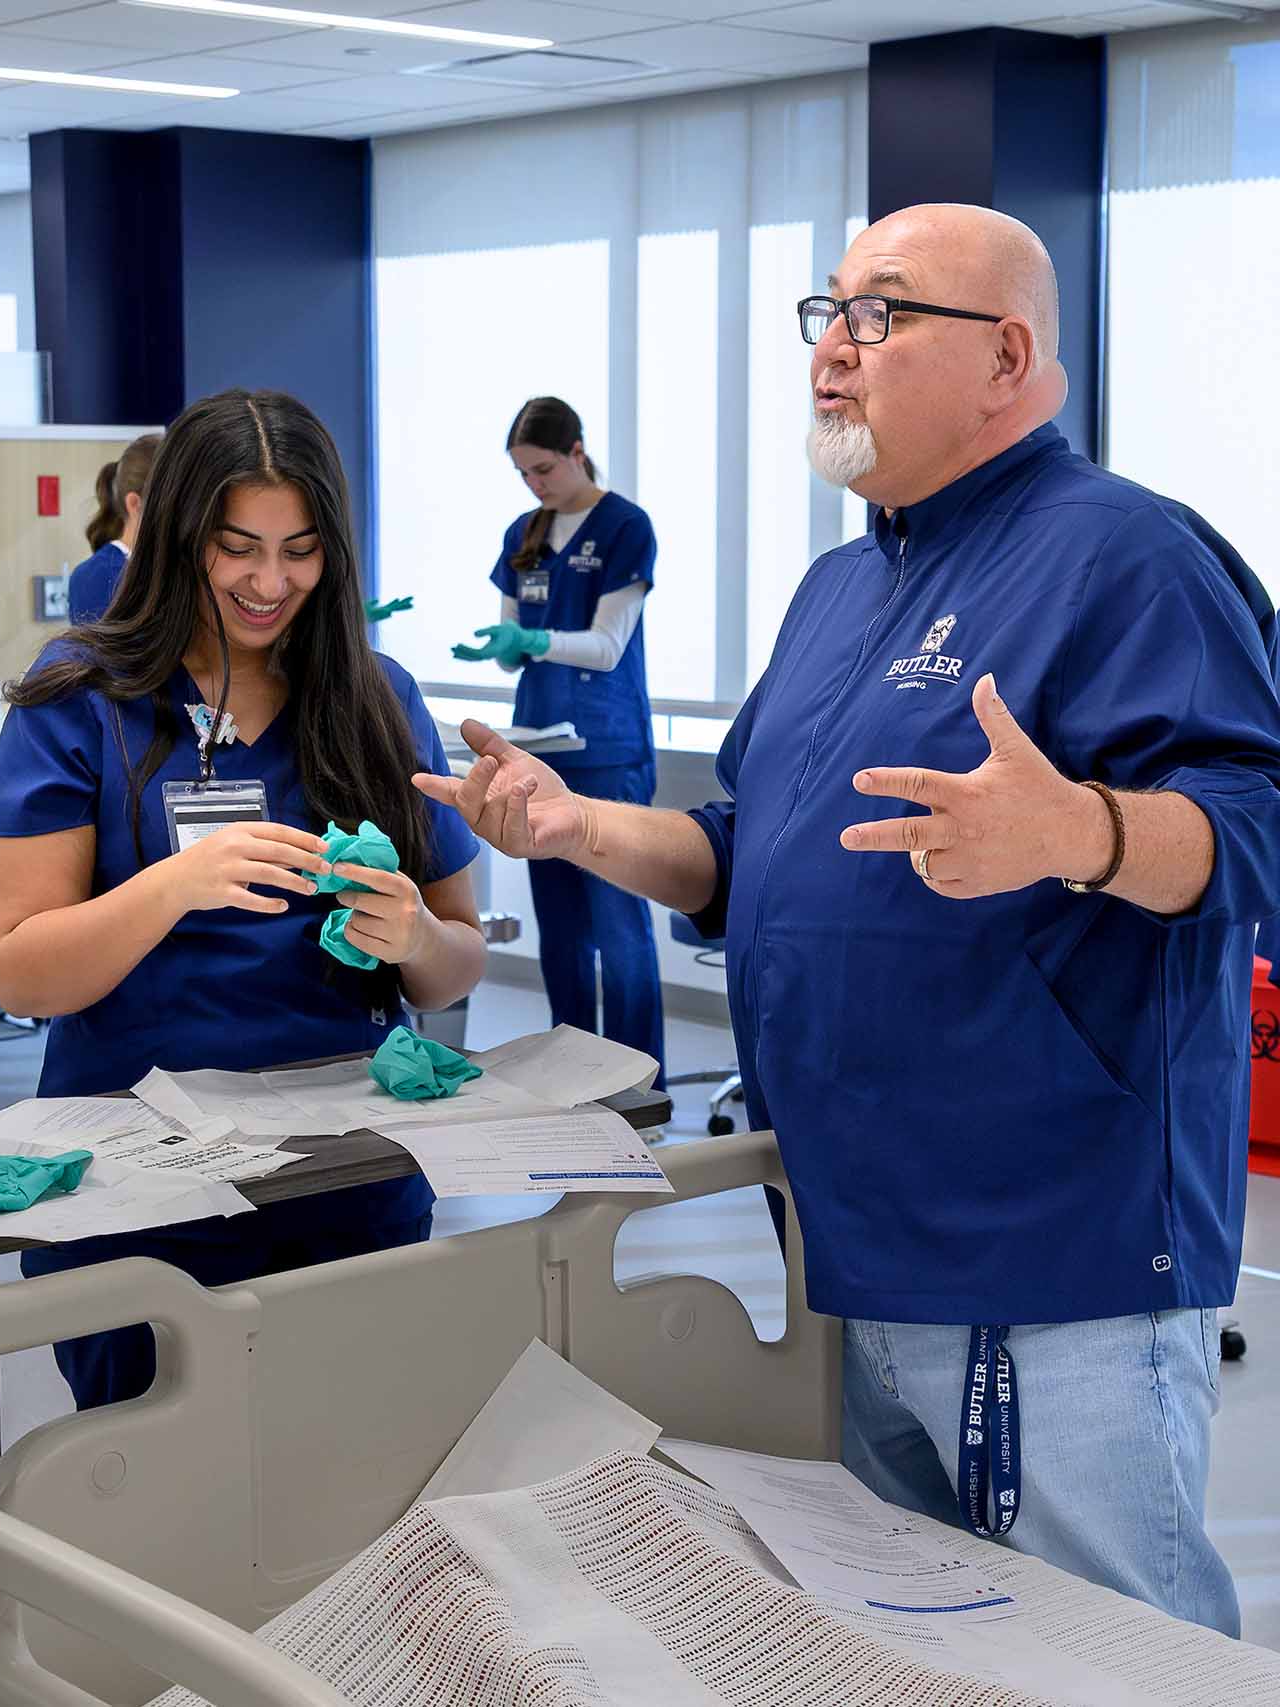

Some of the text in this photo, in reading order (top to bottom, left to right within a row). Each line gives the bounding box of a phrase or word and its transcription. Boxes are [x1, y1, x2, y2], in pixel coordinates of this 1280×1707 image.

[886, 655, 963, 677] BUTLER
[969, 1326, 988, 1426] BUTLER UNIVE
[997, 1346, 1010, 1474] UTLER UNIVERSITY
[969, 1461, 979, 1525] UNIVERSITY
